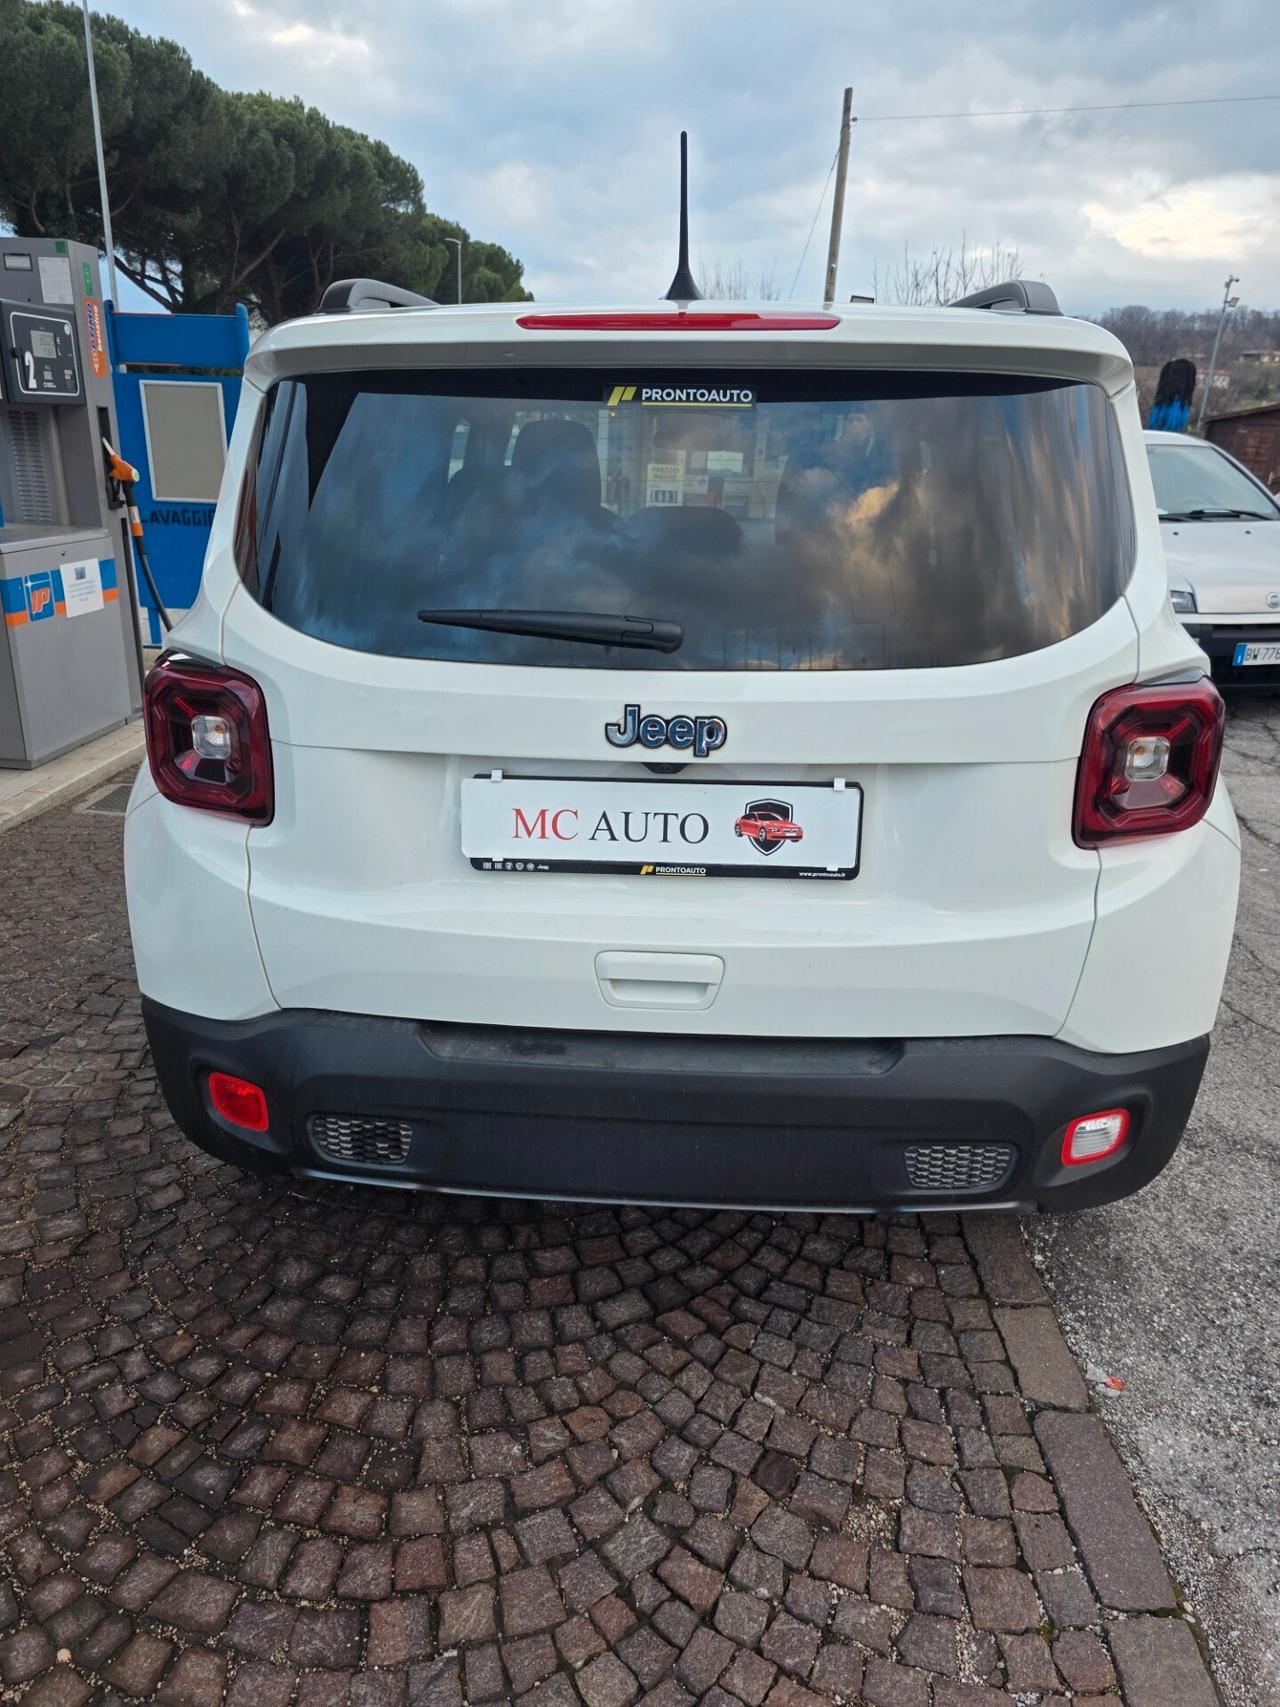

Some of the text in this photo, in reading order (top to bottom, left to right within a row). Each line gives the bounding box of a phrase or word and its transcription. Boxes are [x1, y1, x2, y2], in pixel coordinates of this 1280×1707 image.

[24, 350, 37, 389] 2
[641, 388, 753, 402] PRONTOAUTO
[604, 704, 727, 757] Jeep
[512, 807, 710, 844] MC AUTO
[655, 866, 706, 874] PRONTOAUTO
